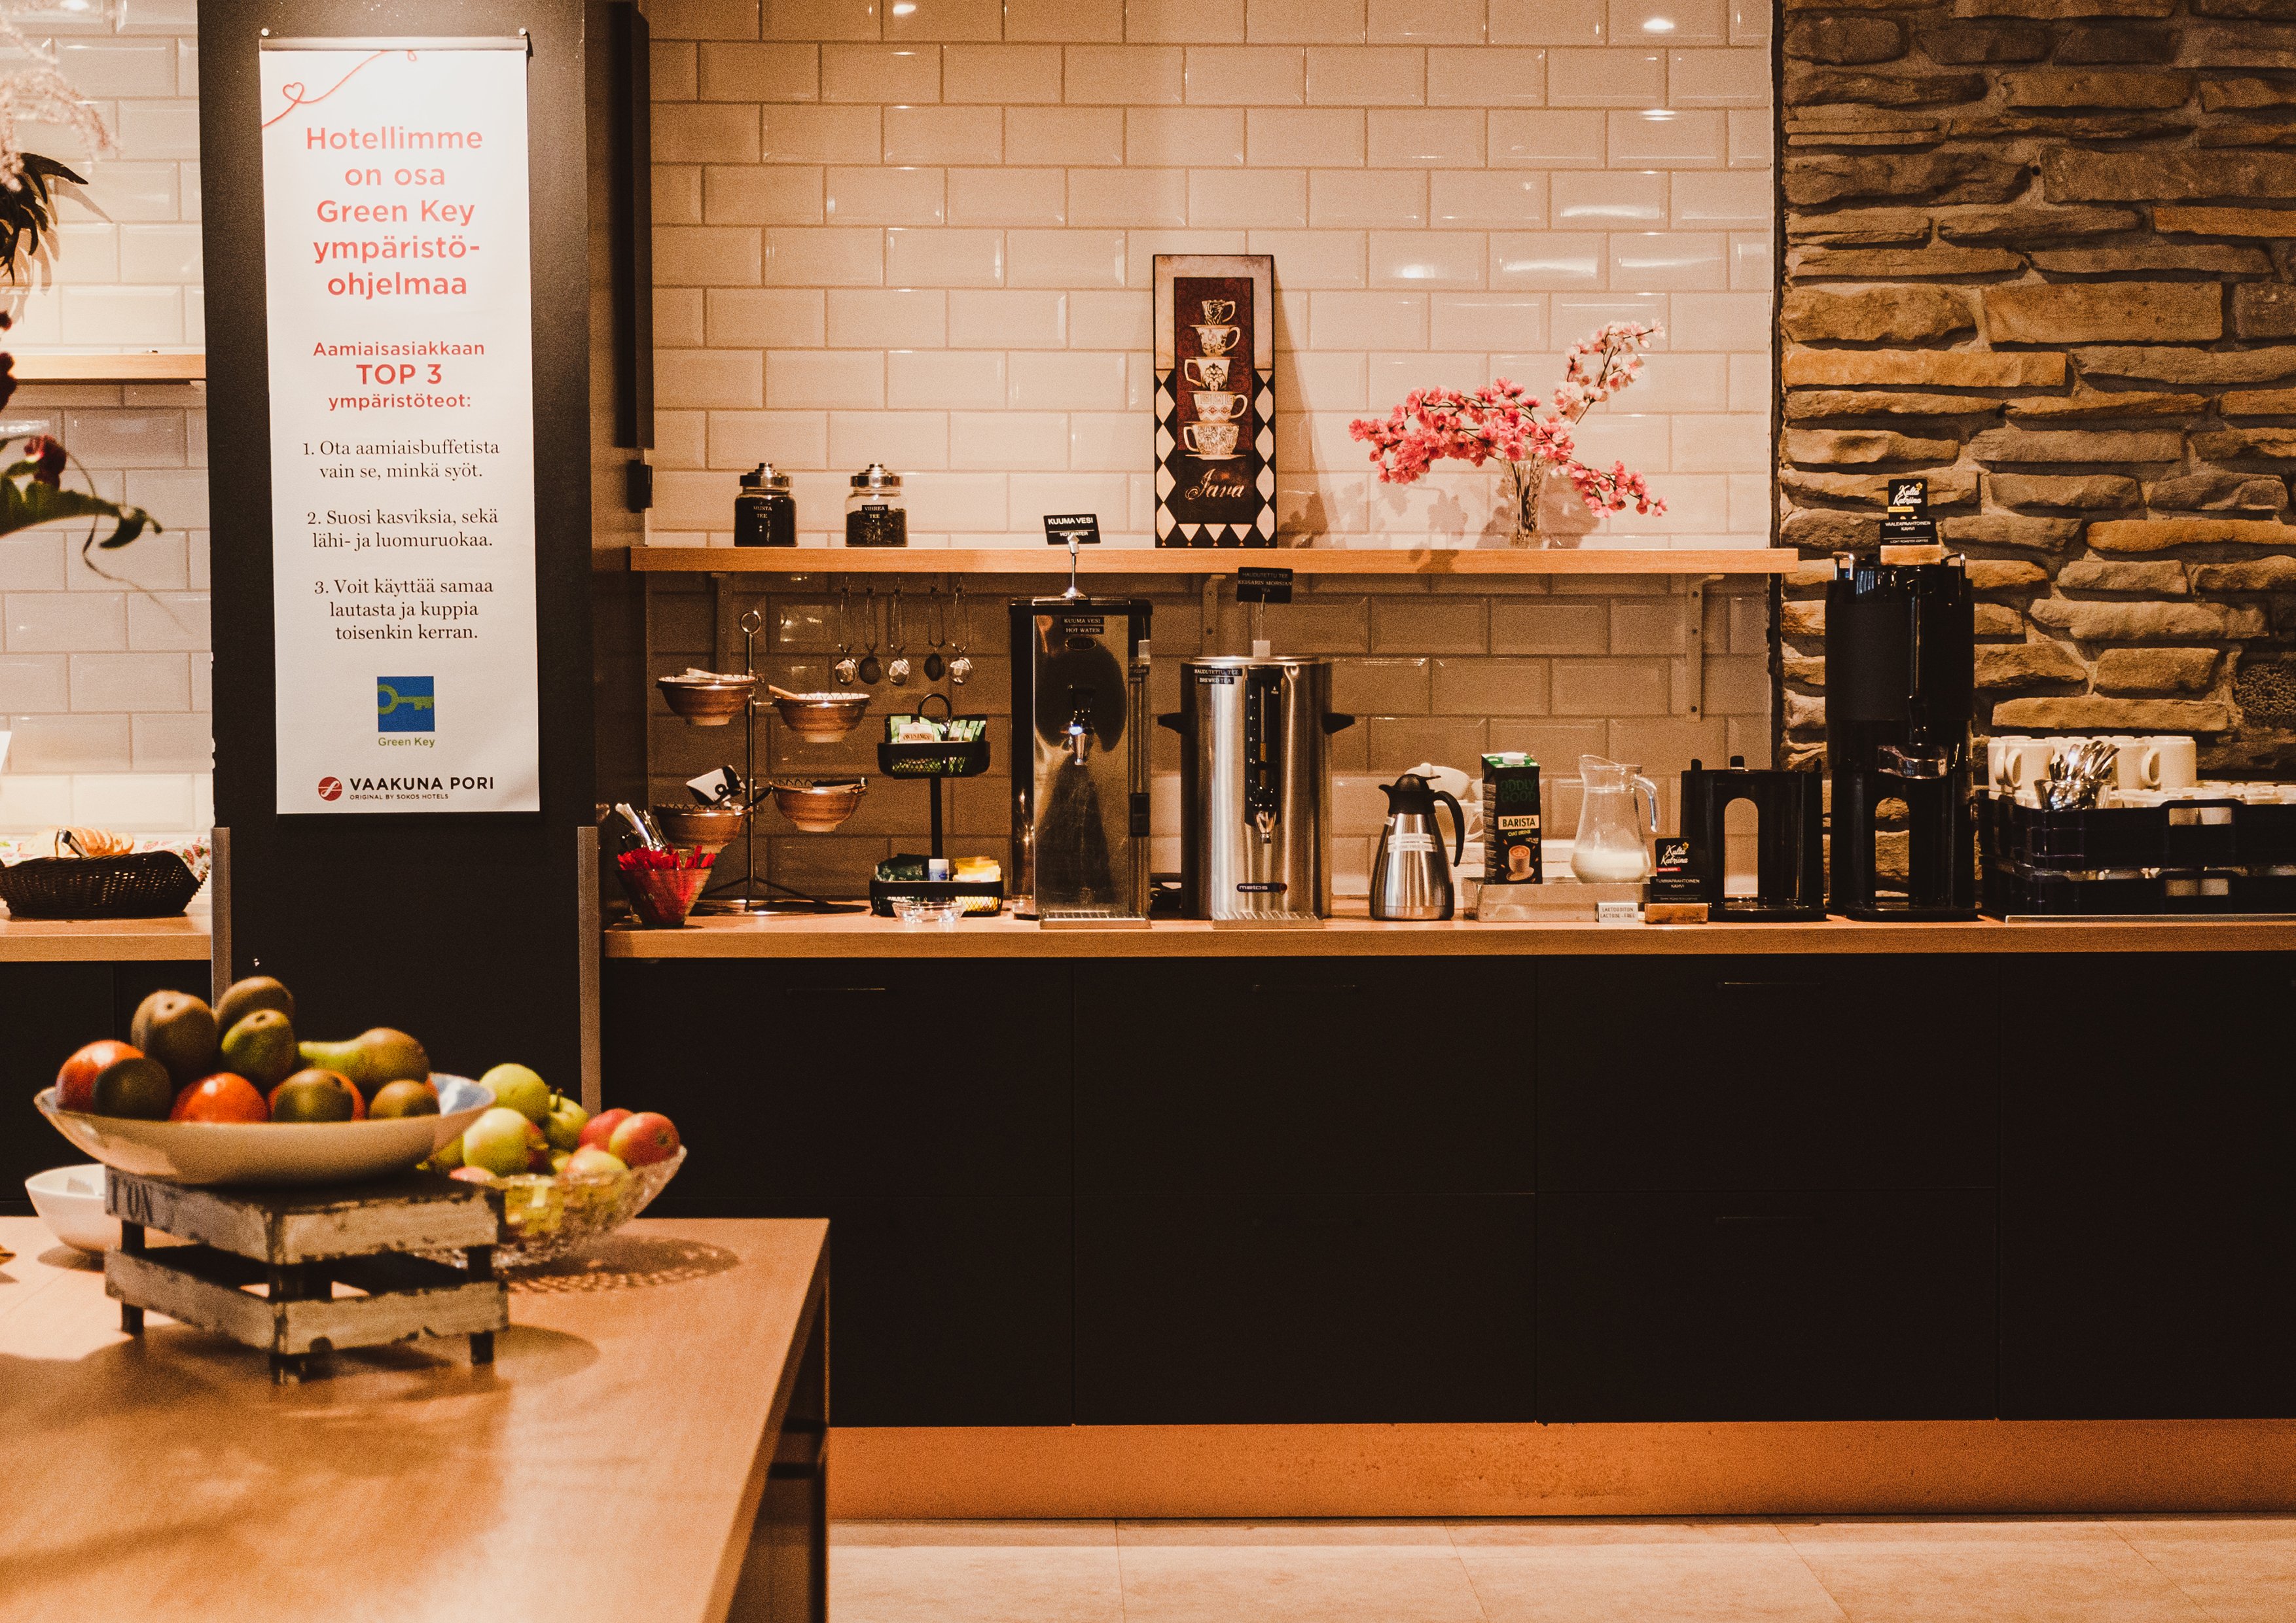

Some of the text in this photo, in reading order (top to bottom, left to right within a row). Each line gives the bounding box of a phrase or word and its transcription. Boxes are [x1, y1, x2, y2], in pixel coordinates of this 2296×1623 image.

[306, 126, 483, 150] Hotellimme
[344, 168, 445, 186] on osa
[317, 200, 475, 226] Green Key
[313, 235, 480, 264] ympäristö-
[327, 272, 467, 300] ohjelmaa
[313, 341, 484, 357] Aamiaisasiakkaan
[356, 363, 442, 385] TOP 3
[328, 393, 471, 412] ympäristöteot:
[303, 439, 500, 455] 1. Ota aamiaisbuffetista
[319, 462, 482, 482] vain se, minkä syöt.
[1185, 468, 1245, 501] Java
[307, 507, 499, 526] 2. Suosi kasviksia, sekä
[312, 531, 493, 552] lähi- ja luomuruokaa.
[314, 578, 494, 597] 3. Voit käyttää samaa
[329, 601, 479, 620] lautasta ja kuppia
[335, 624, 478, 640] toisenkin kerran.
[378, 737, 435, 748] Green Key
[350, 777, 494, 791] VAAKUNA PORI
[1499, 778, 1536, 792] ODDLY
[1500, 790, 1536, 803] GOOD
[1502, 818, 1536, 827] BARISTA
[1665, 844, 1686, 856] Kulta
[1660, 854, 1689, 866] Katriina
